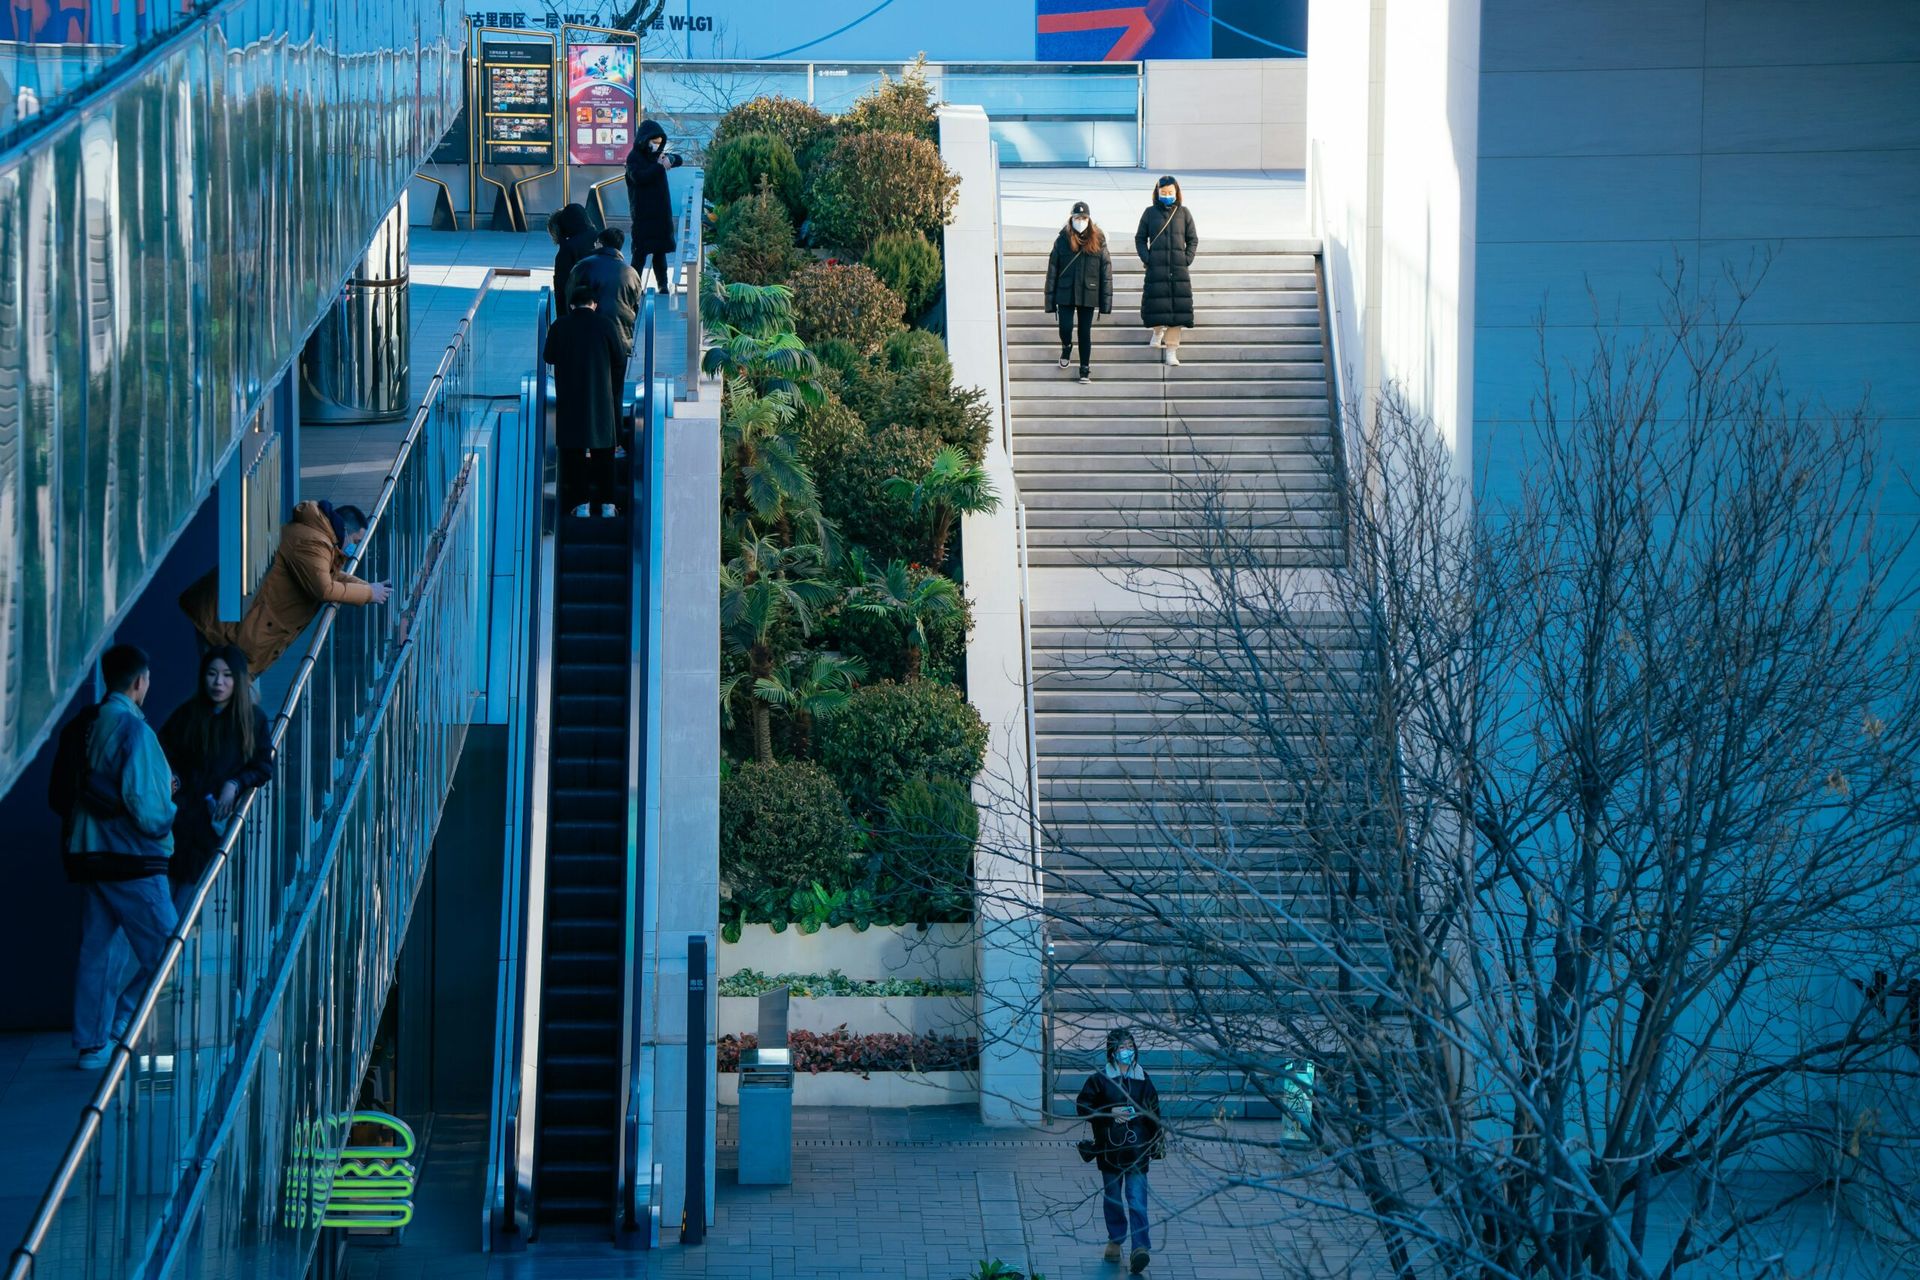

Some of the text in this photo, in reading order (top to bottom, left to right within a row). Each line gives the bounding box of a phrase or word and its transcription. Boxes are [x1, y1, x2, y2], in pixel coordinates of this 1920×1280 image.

[466, 12, 526, 28] 古里西区
[532, 13, 559, 28] 一层
[669, 15, 713, 31] W-LG1
